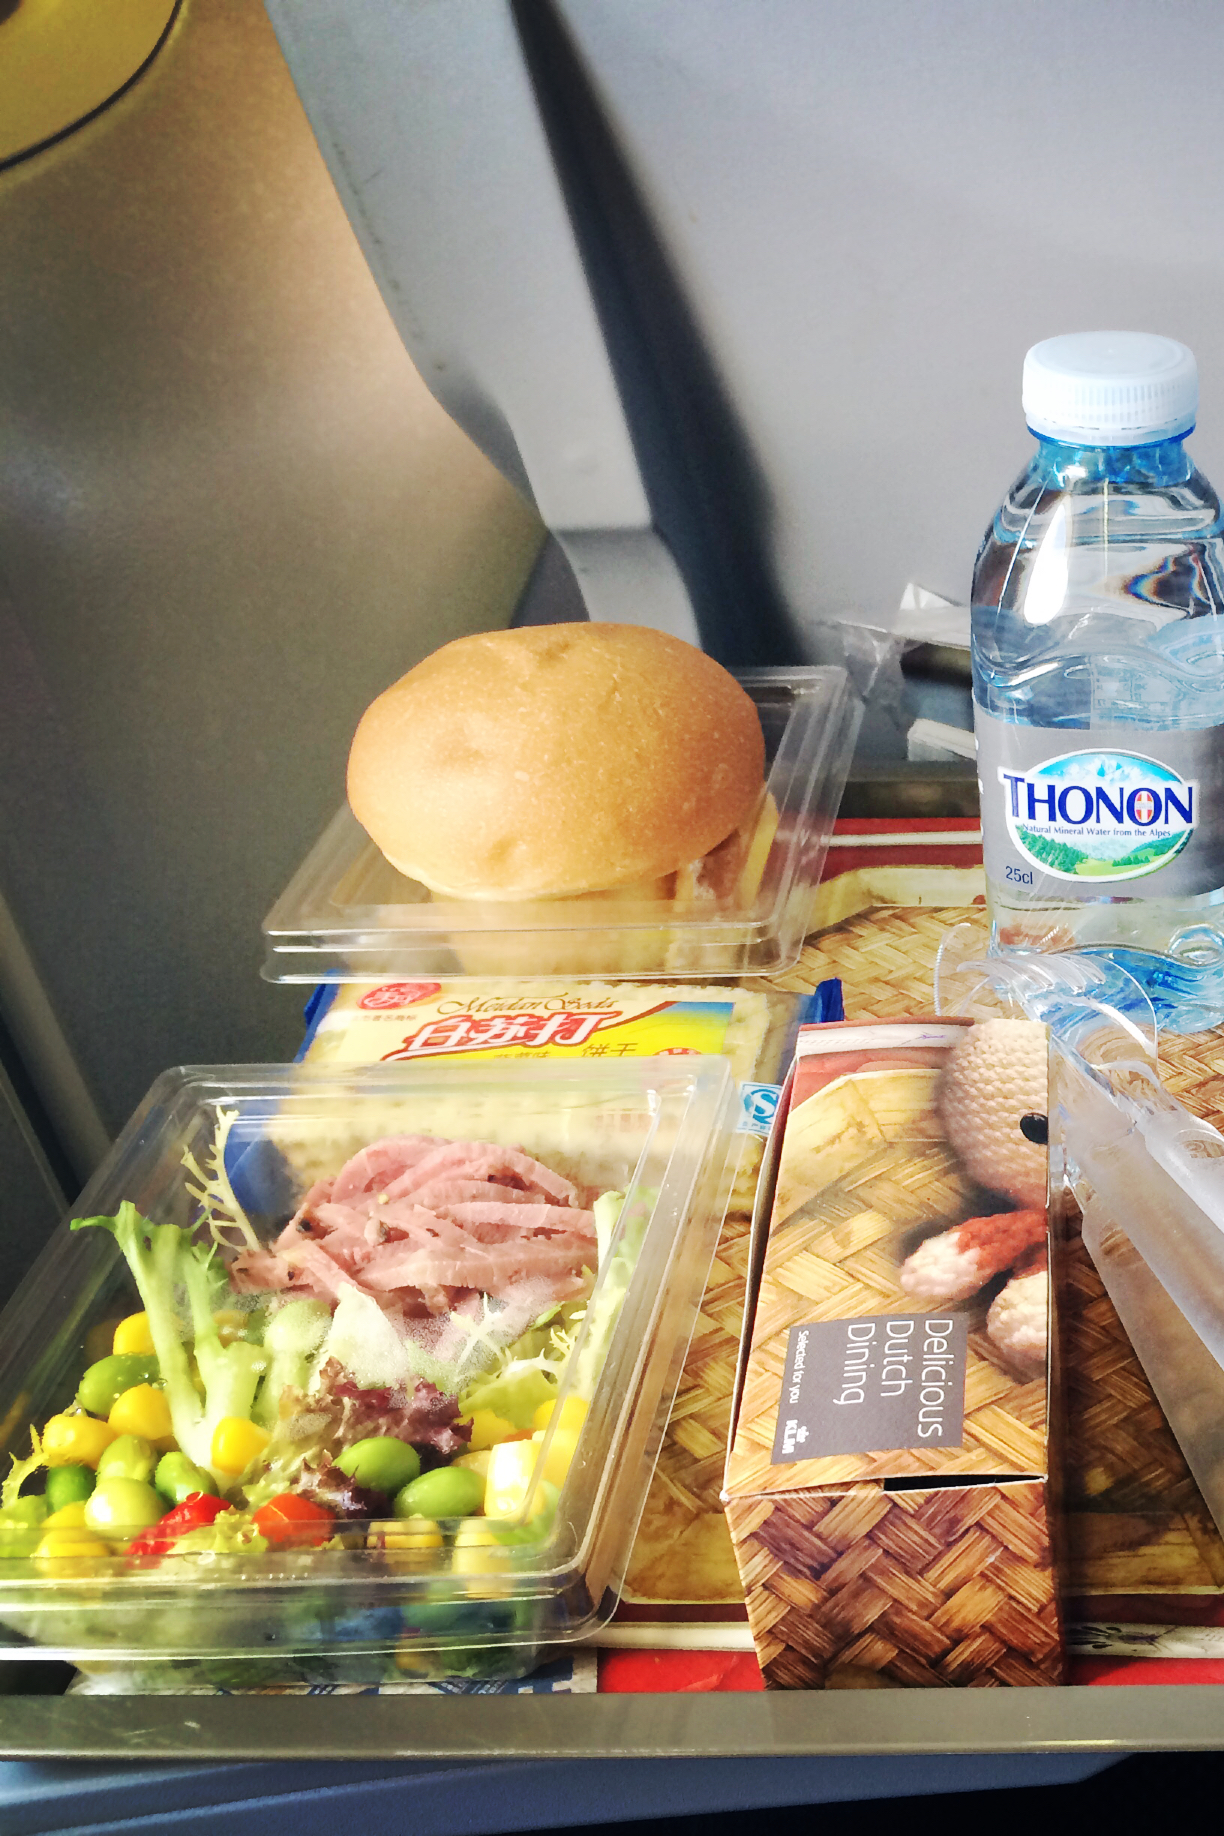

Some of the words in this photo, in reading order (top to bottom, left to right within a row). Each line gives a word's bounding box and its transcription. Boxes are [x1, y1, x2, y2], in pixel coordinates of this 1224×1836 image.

[1003, 773, 1193, 827] THONON
[1022, 823, 1051, 834] Natural
[1053, 826, 1084, 836] Mineral
[1087, 827, 1111, 836] Water
[1113, 826, 1132, 837] from
[1134, 827, 1147, 837] the
[1149, 828, 1172, 839] Alpes
[1004, 865, 1034, 886] 25cl
[543, 993, 619, 1012] Soda
[407, 1011, 622, 1052] 白苏打
[793, 1330, 810, 1370] Selected
[832, 1322, 878, 1405] Dining
[880, 1319, 915, 1397] Dutch
[788, 1384, 801, 1404] you
[792, 1370, 805, 1384] for
[917, 1319, 955, 1439] Delicious
[781, 1419, 799, 1455] KLM
